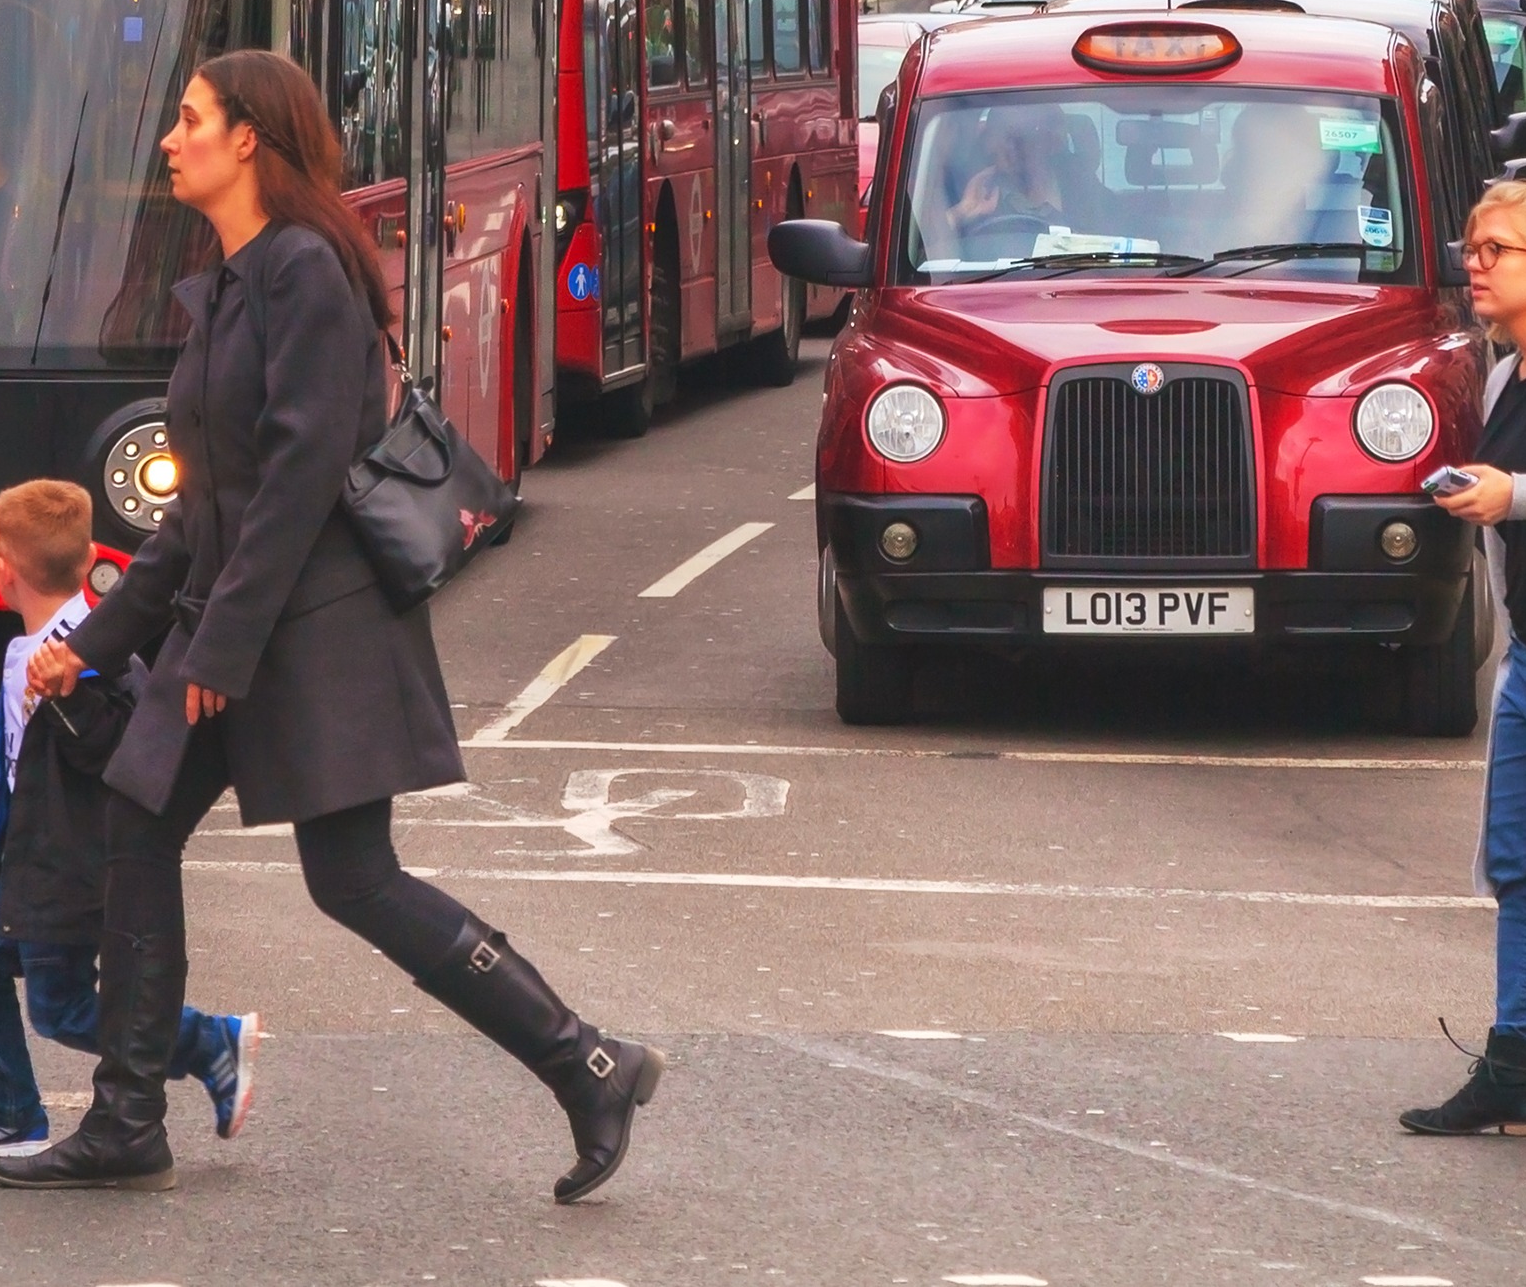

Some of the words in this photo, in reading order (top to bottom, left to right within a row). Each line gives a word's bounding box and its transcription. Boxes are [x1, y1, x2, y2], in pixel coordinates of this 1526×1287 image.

[1112, 30, 1207, 57] TAXI
[1065, 591, 1147, 626] LO13
[1158, 591, 1230, 626] PVF
